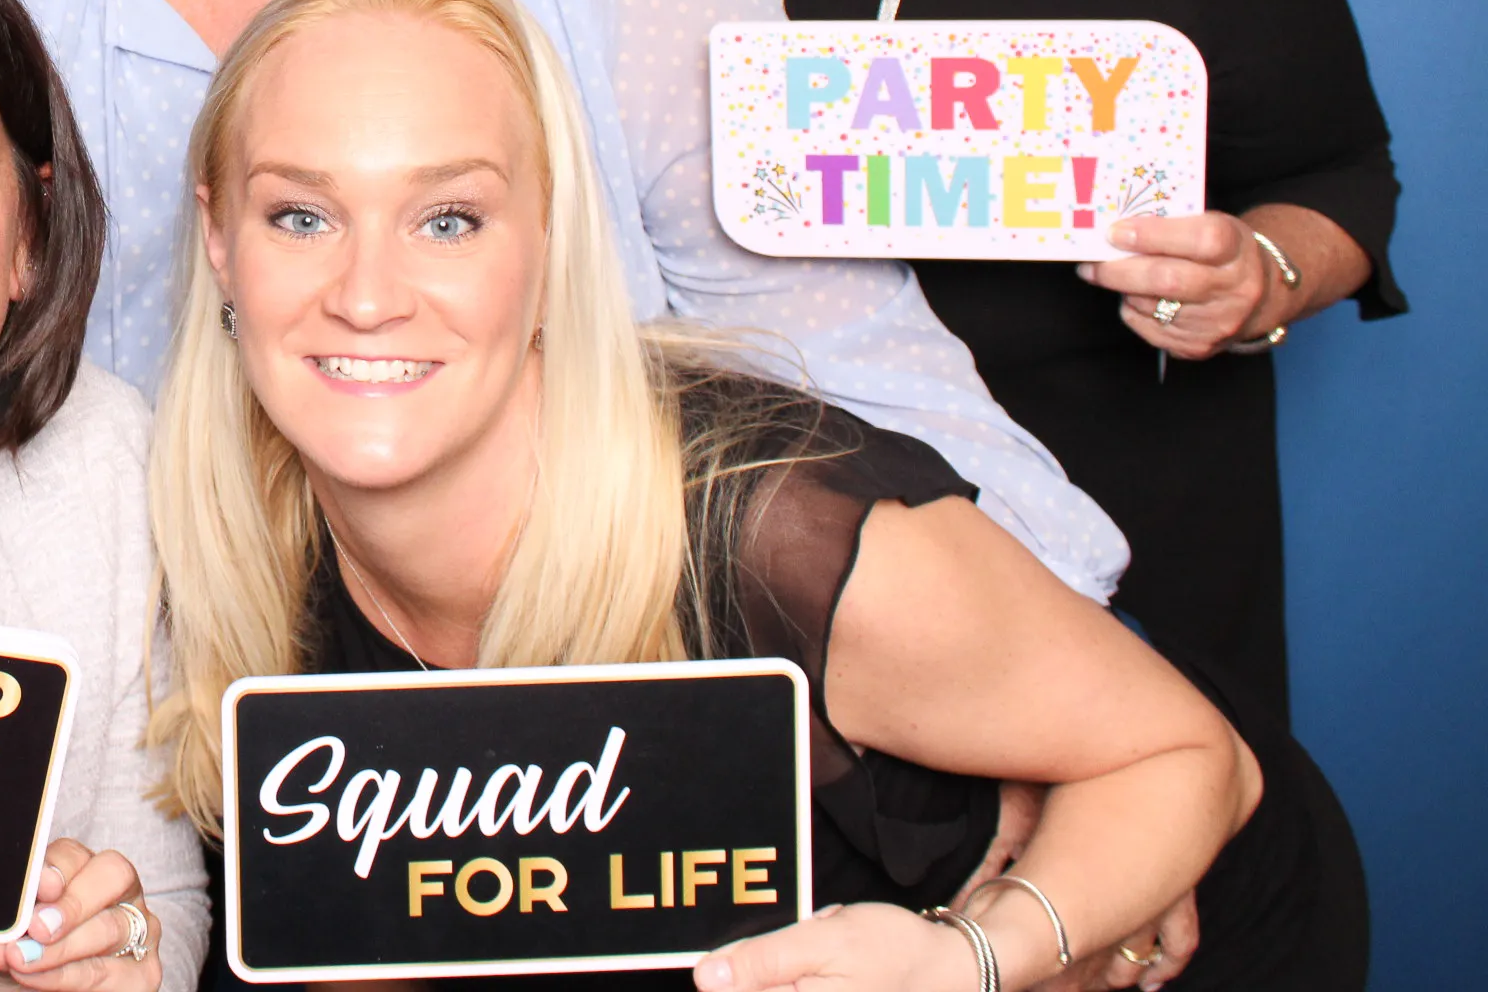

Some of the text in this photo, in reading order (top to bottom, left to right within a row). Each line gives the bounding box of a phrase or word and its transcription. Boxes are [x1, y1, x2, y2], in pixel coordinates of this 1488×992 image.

[785, 57, 1140, 132] PARTY
[805, 155, 1098, 228] TIME!
[259, 726, 630, 879] Squad
[408, 847, 777, 917] FOR LIFE
